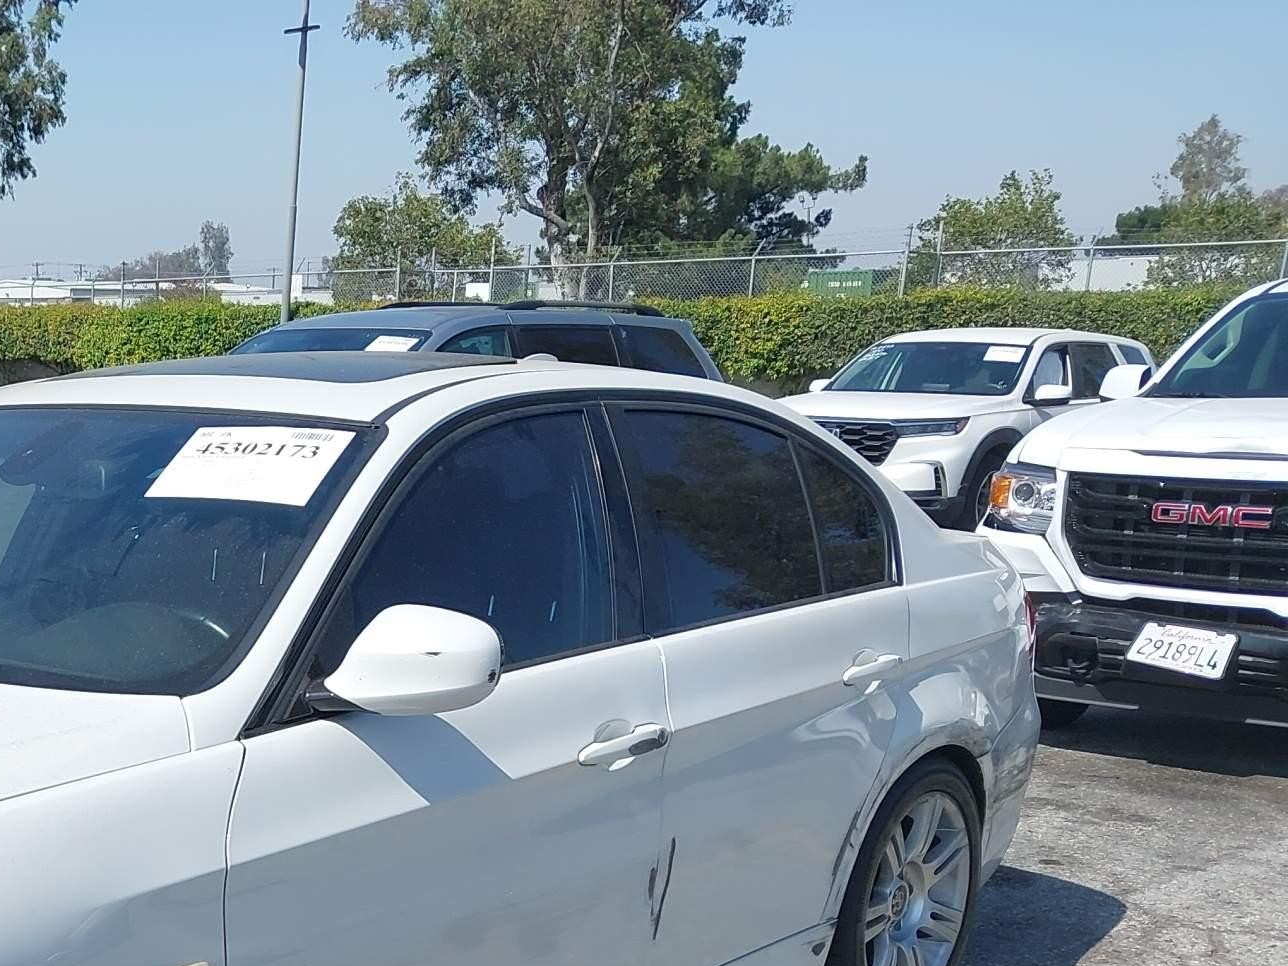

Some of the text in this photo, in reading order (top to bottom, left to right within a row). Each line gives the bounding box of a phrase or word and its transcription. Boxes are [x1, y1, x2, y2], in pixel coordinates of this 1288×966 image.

[196, 441, 321, 459] 45302173
[1151, 502, 1273, 529] GMC
[1136, 637, 1218, 670] 29189L4
